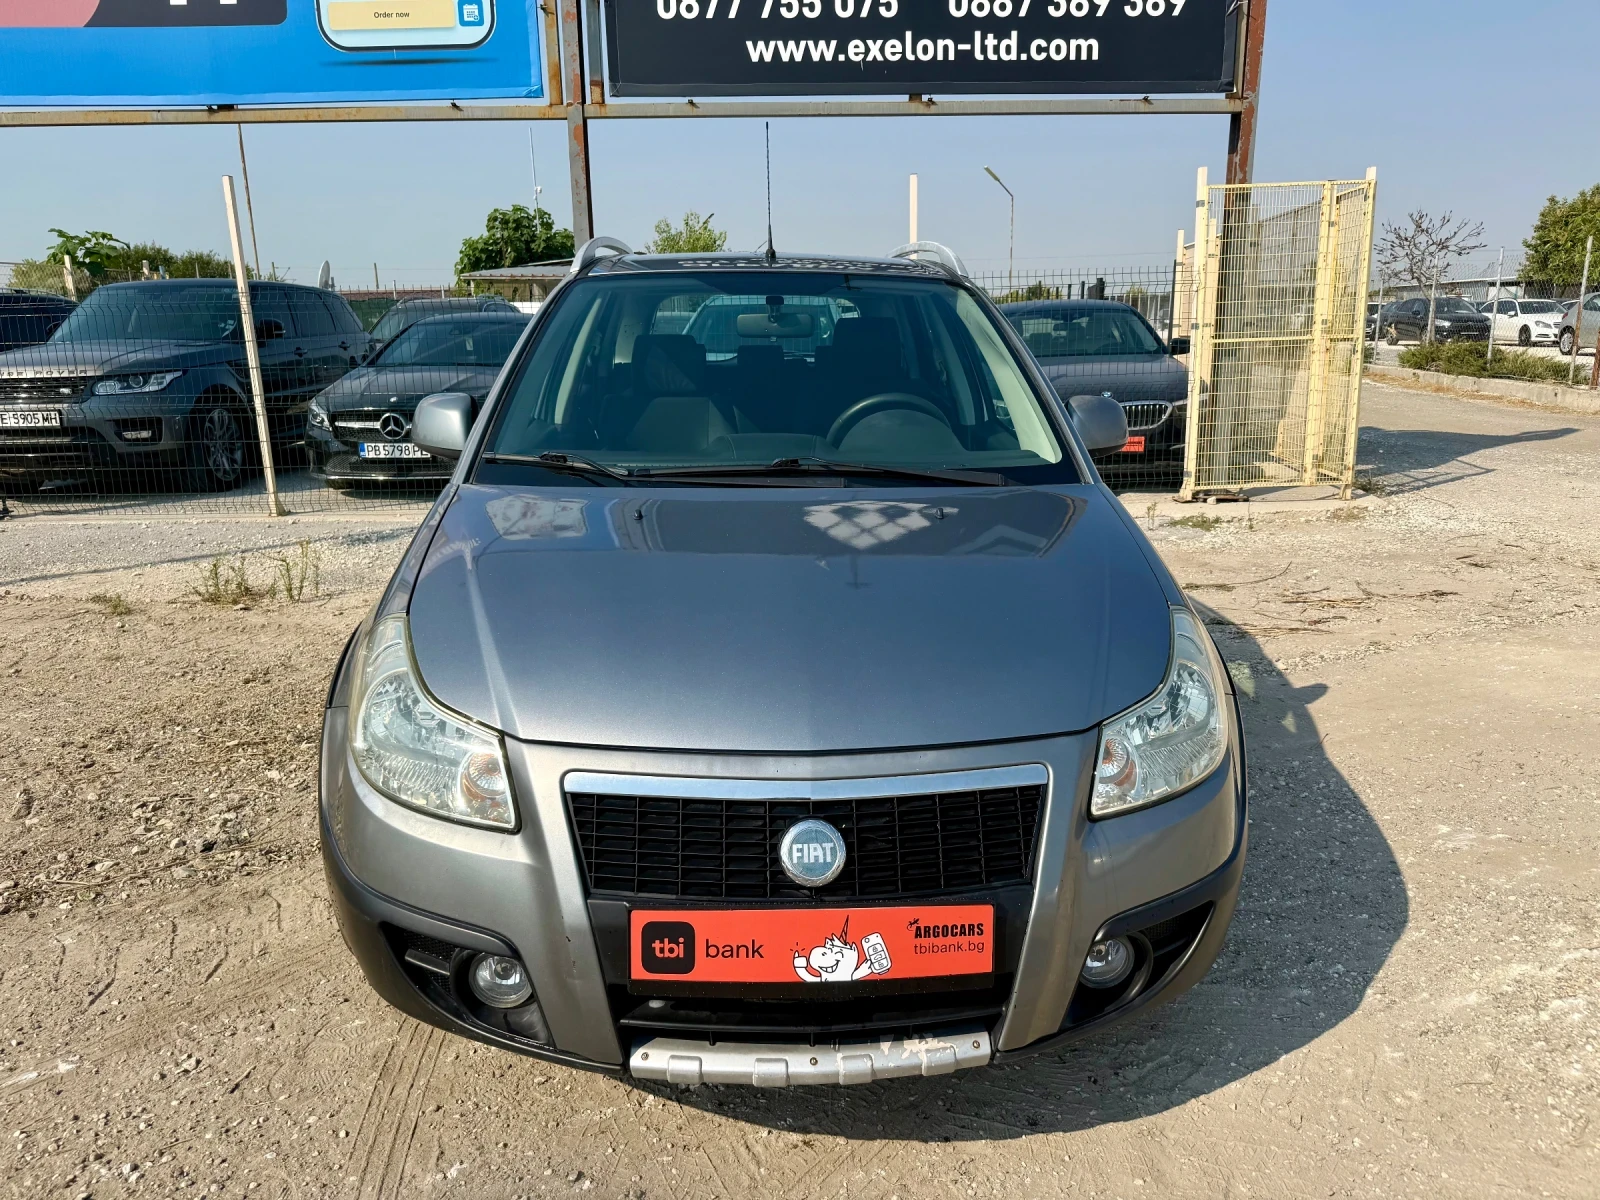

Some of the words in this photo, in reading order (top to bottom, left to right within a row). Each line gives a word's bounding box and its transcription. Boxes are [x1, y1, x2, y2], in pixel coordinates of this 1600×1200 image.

[745, 30, 1100, 62] www.exelon-ltd.com
[12, 413, 40, 424] 5905
[791, 841, 836, 864] FIAT
[913, 922, 985, 940] ARGOCARS
[651, 937, 685, 959] tbi
[704, 938, 765, 959] bank
[913, 940, 985, 956] tbibank.bg
